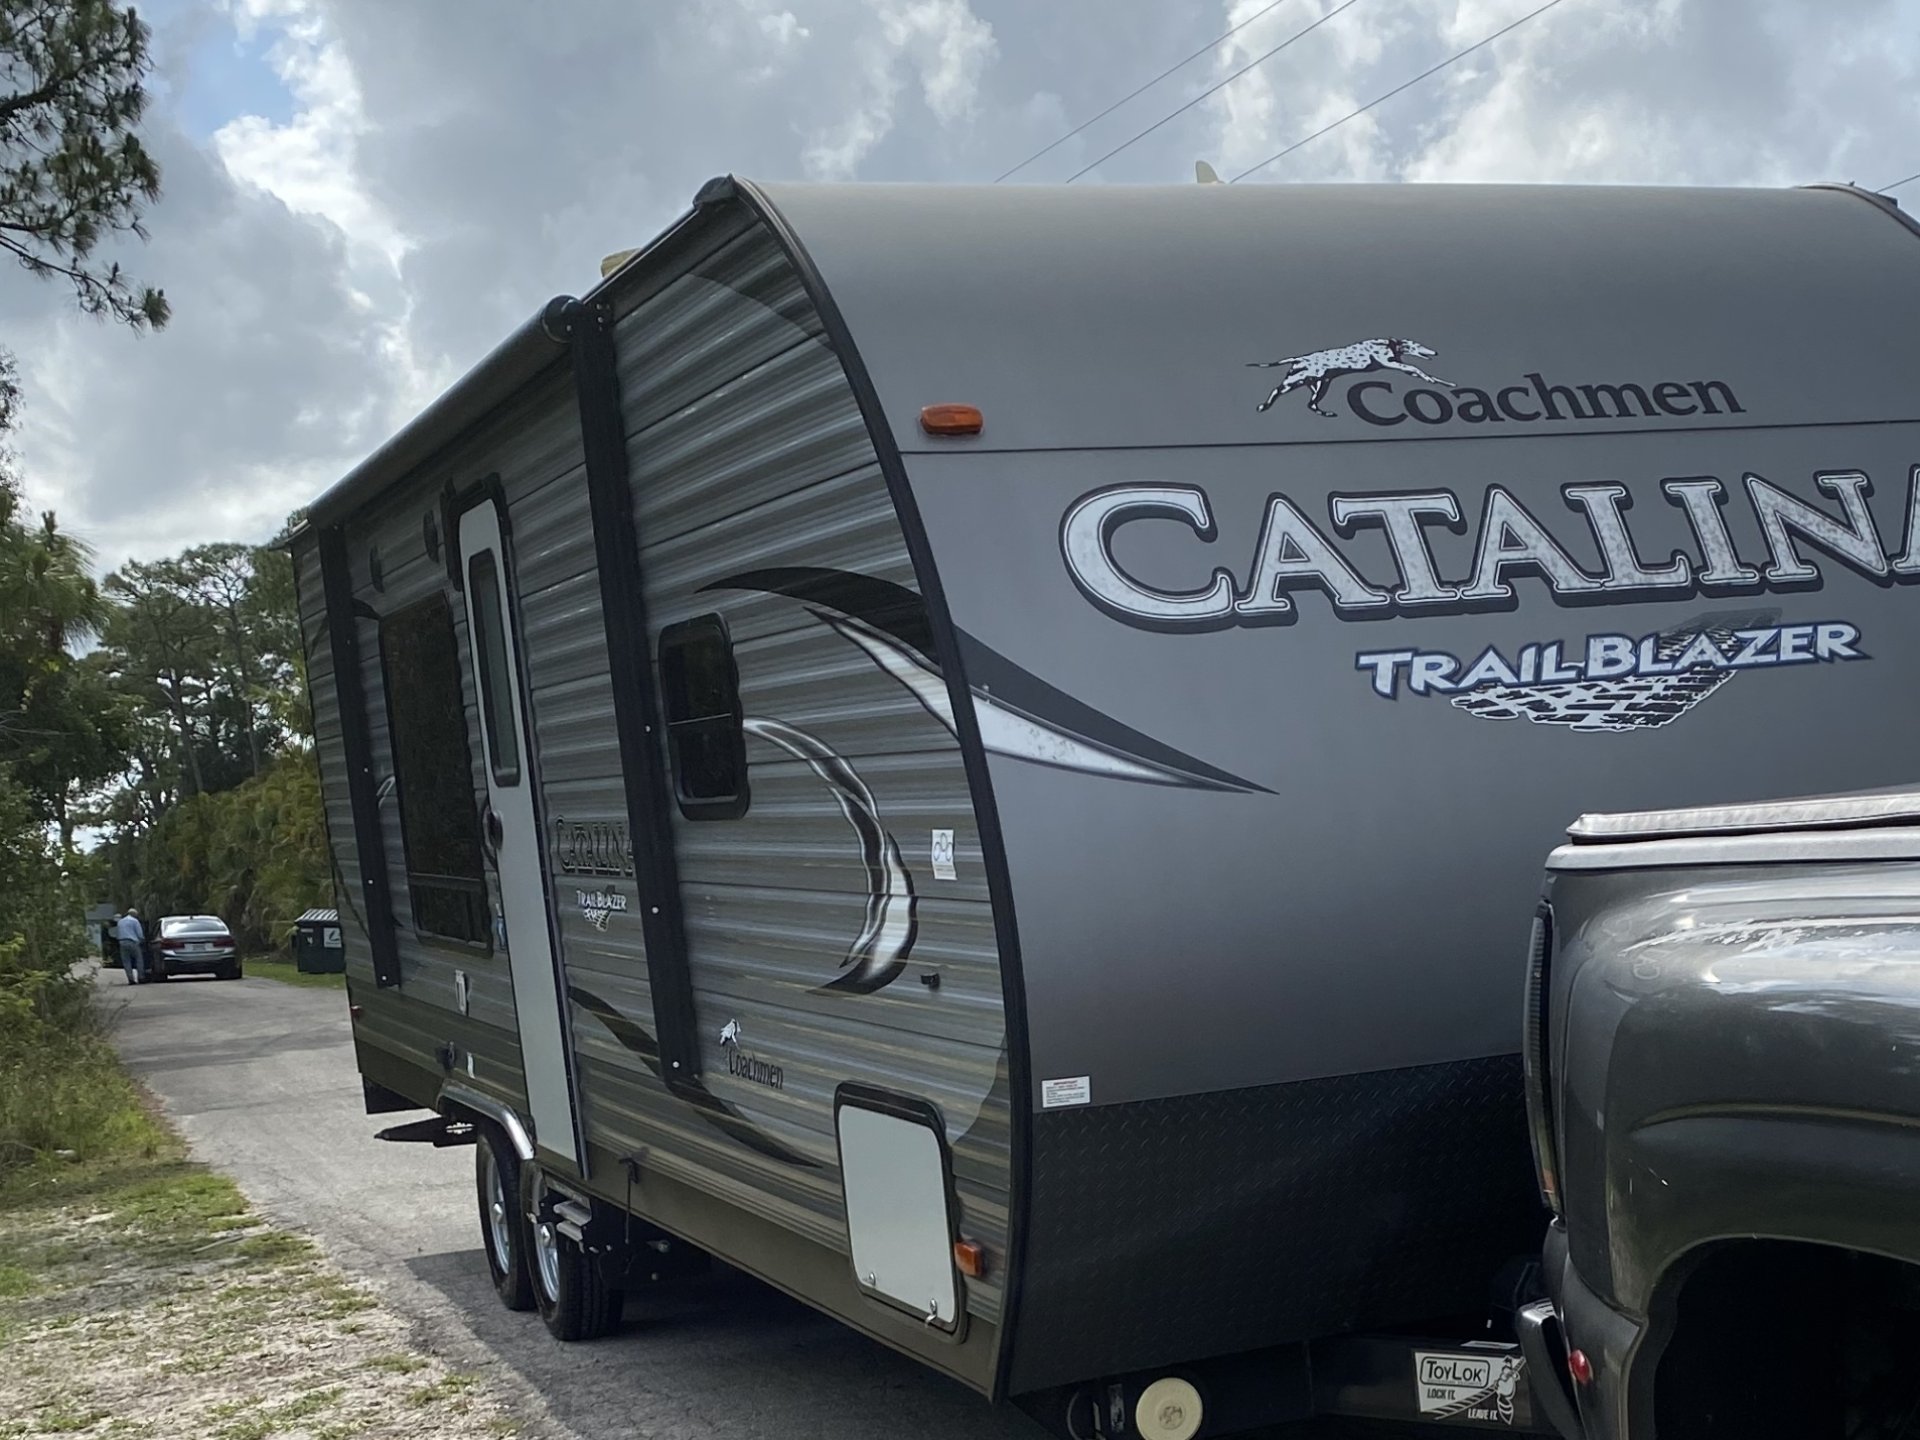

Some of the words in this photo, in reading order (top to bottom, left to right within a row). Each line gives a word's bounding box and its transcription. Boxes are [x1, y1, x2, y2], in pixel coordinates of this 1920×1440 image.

[1346, 373, 1746, 426] Coachmen
[1058, 463, 1920, 635] CATALIN
[1356, 621, 1872, 699] TRAILBLAZER
[576, 889, 627, 911] TRAILBLAZER
[729, 1049, 783, 1090] Coachmen
[1426, 1388, 1446, 1400] LOCK
[1467, 1408, 1489, 1420] LEAVE
